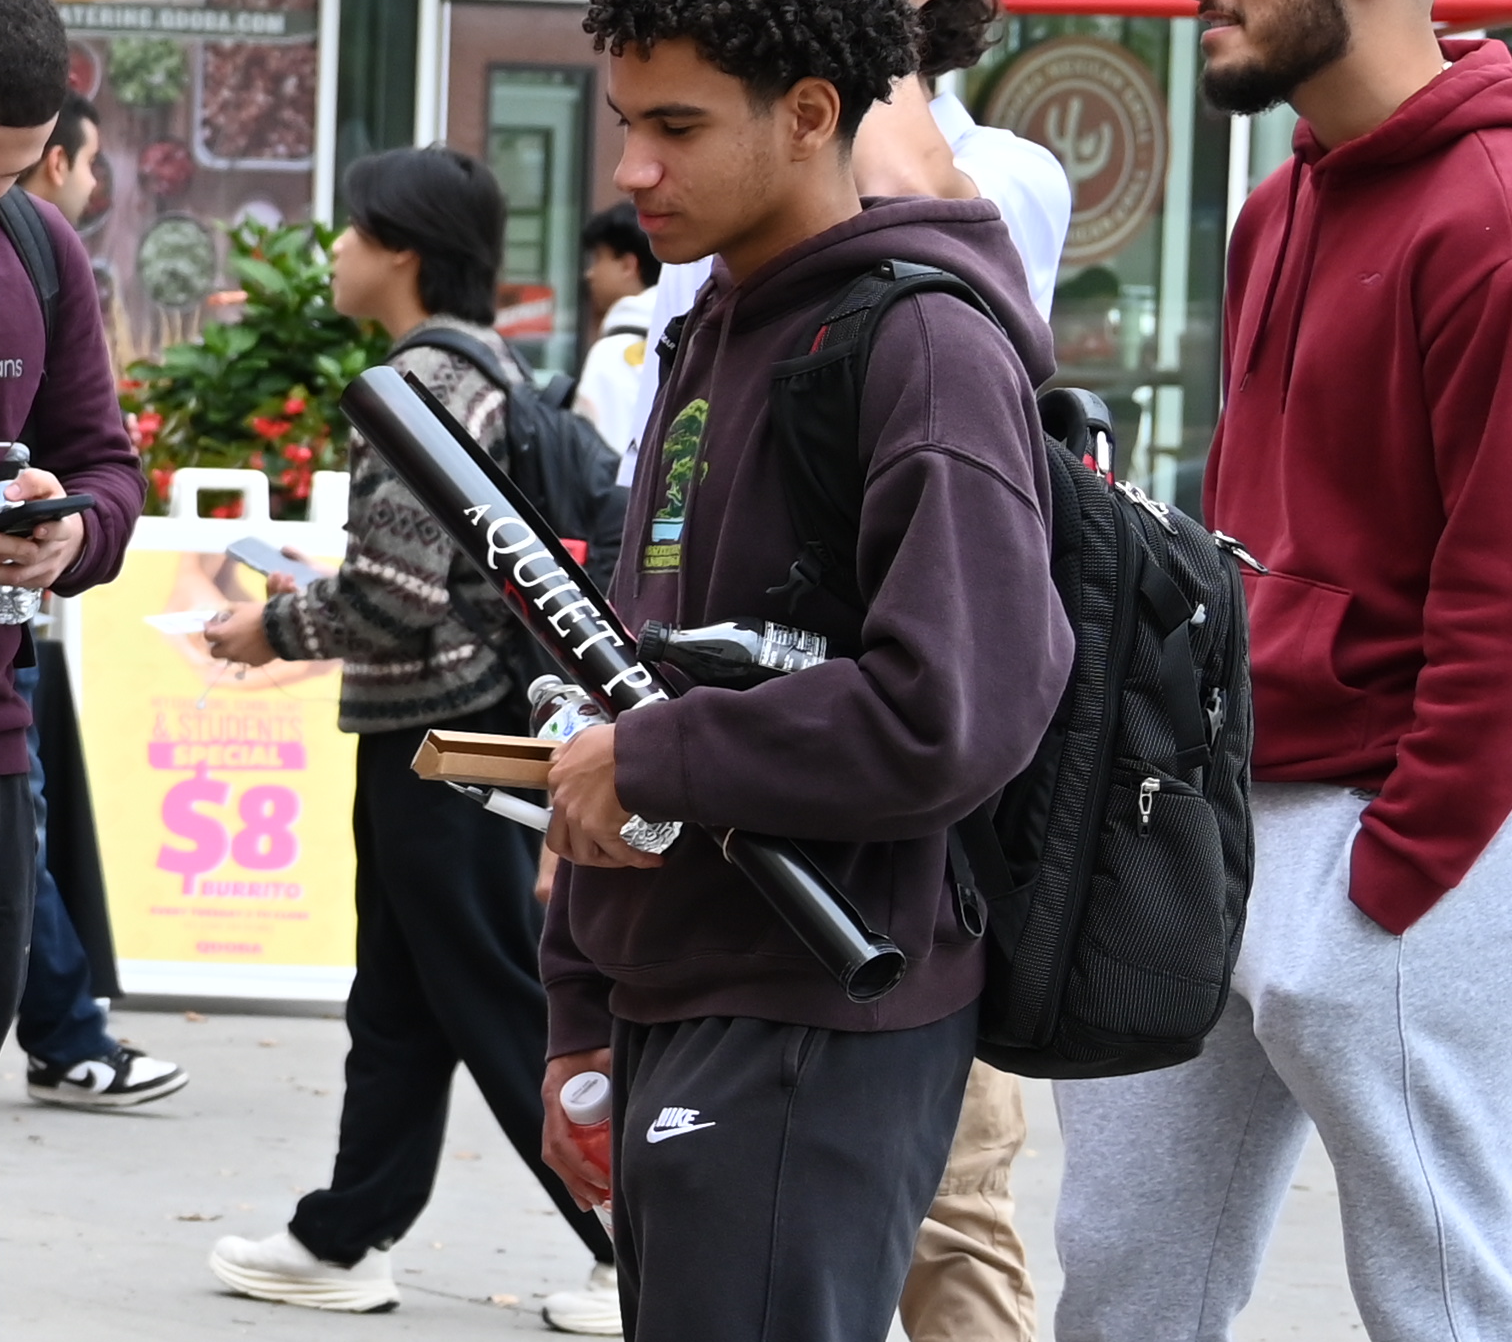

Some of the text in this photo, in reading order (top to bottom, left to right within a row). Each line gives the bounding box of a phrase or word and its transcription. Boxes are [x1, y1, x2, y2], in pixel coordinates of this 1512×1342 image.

[462, 503, 493, 527] A
[486, 516, 626, 660] QUIET
[172, 743, 283, 768] SPECIAL
[155, 761, 301, 896] $8
[201, 880, 303, 900] BURRITO
[655, 1106, 701, 1128] NIKE
